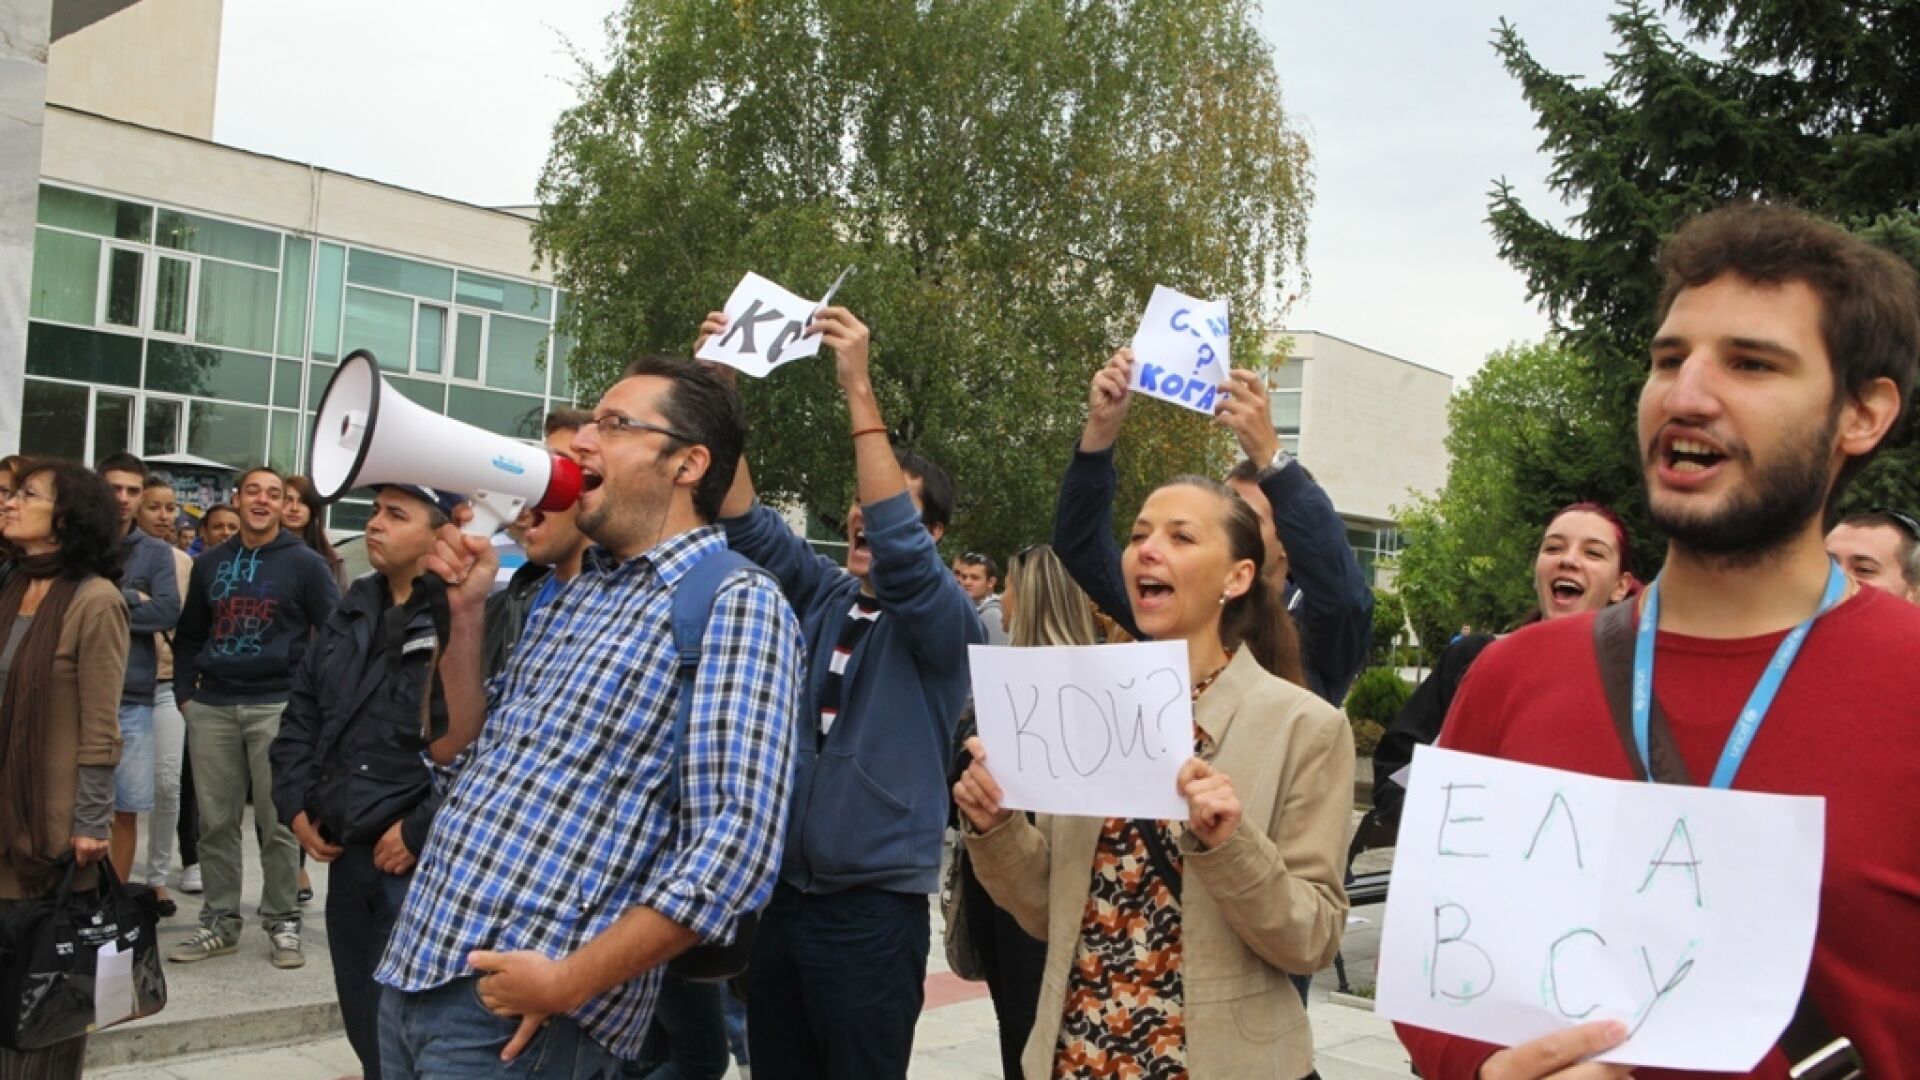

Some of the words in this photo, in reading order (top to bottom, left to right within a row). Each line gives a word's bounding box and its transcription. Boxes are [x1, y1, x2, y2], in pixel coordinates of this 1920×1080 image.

[1004, 667, 1184, 780] КОЙ?
[1729, 718, 1752, 758] unicef
[1436, 783, 1704, 907] ЕЛА
[1429, 902, 1696, 1042] ВСУ
